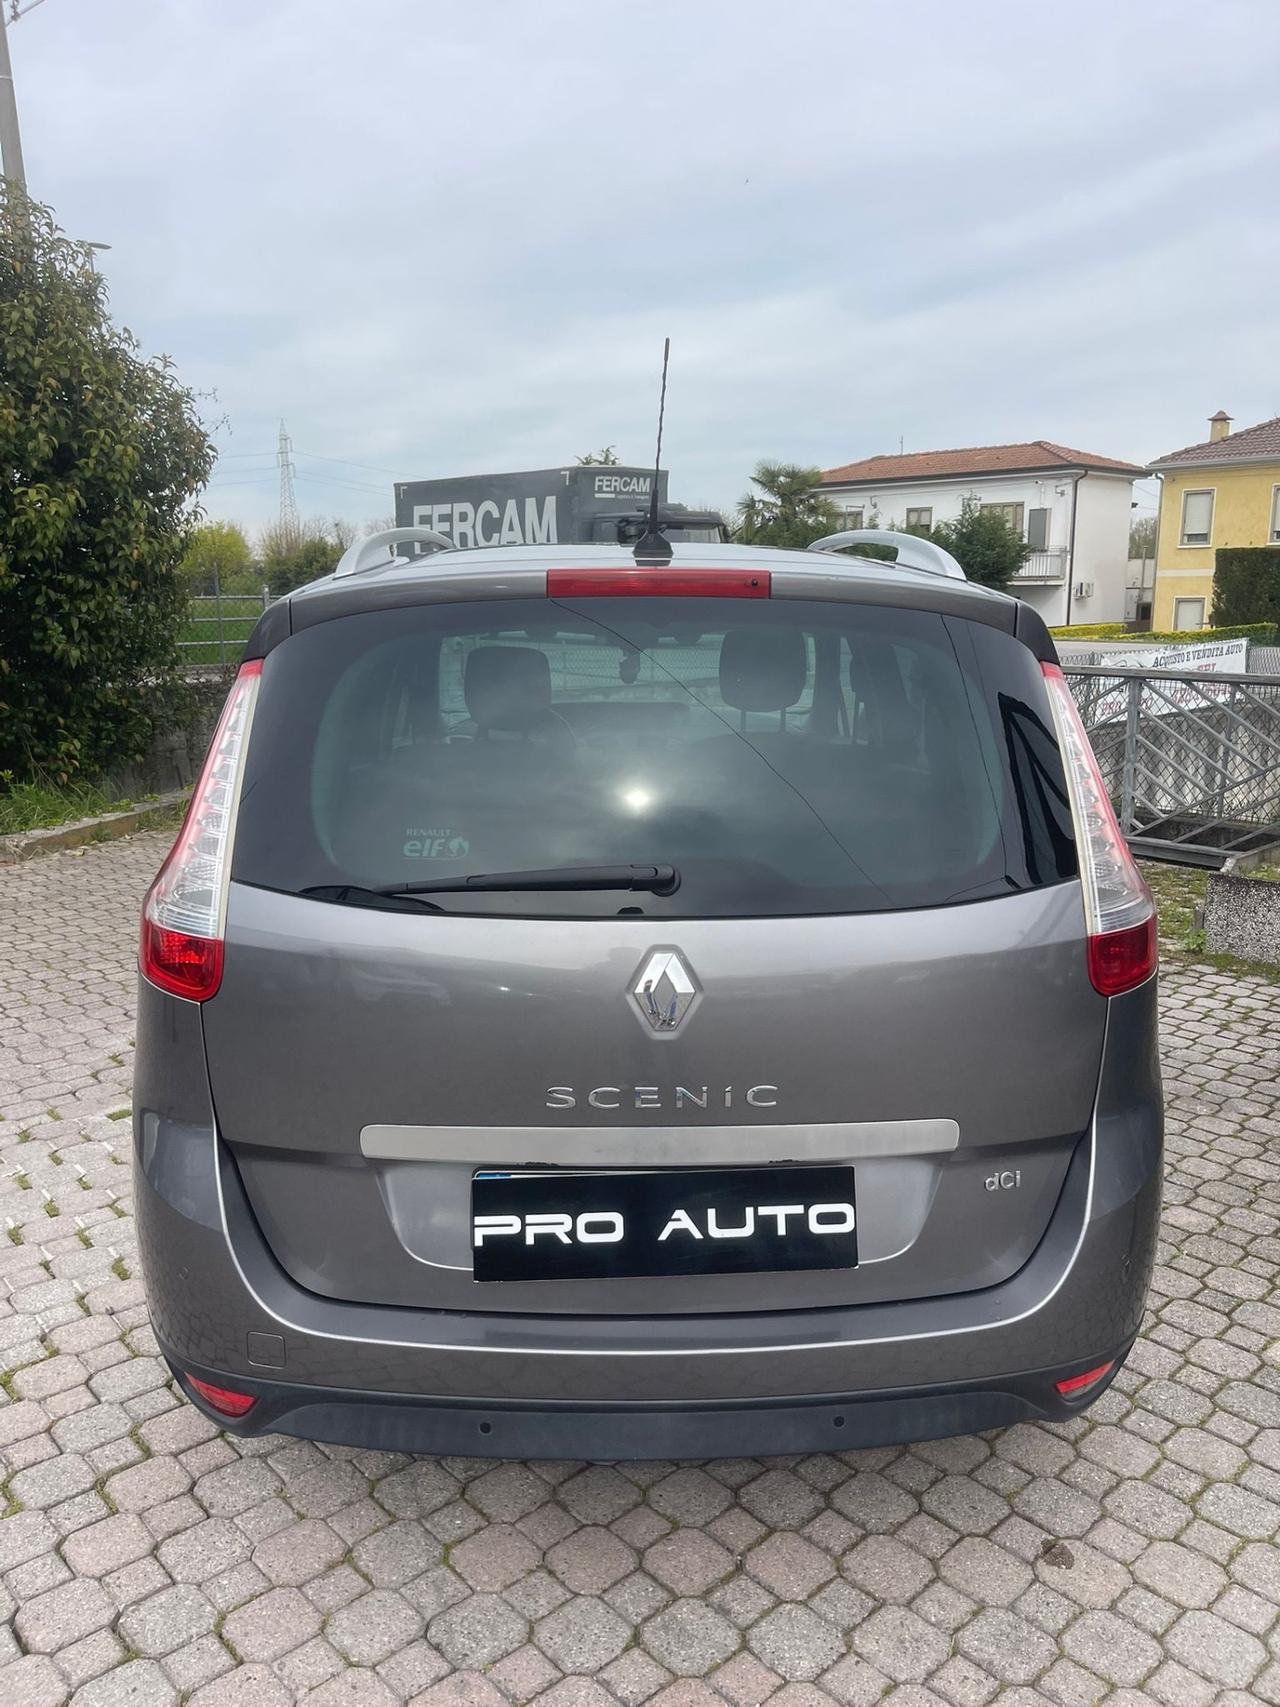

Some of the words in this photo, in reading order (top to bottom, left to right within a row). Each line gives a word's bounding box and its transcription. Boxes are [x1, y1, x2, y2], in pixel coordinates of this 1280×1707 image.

[594, 476, 651, 493] FERCAM
[413, 495, 558, 555] FERCAM
[1185, 650, 1191, 662] E
[1191, 646, 1224, 661] VENDITA
[1224, 643, 1244, 656] AUTO
[406, 828, 452, 837] RENAULT
